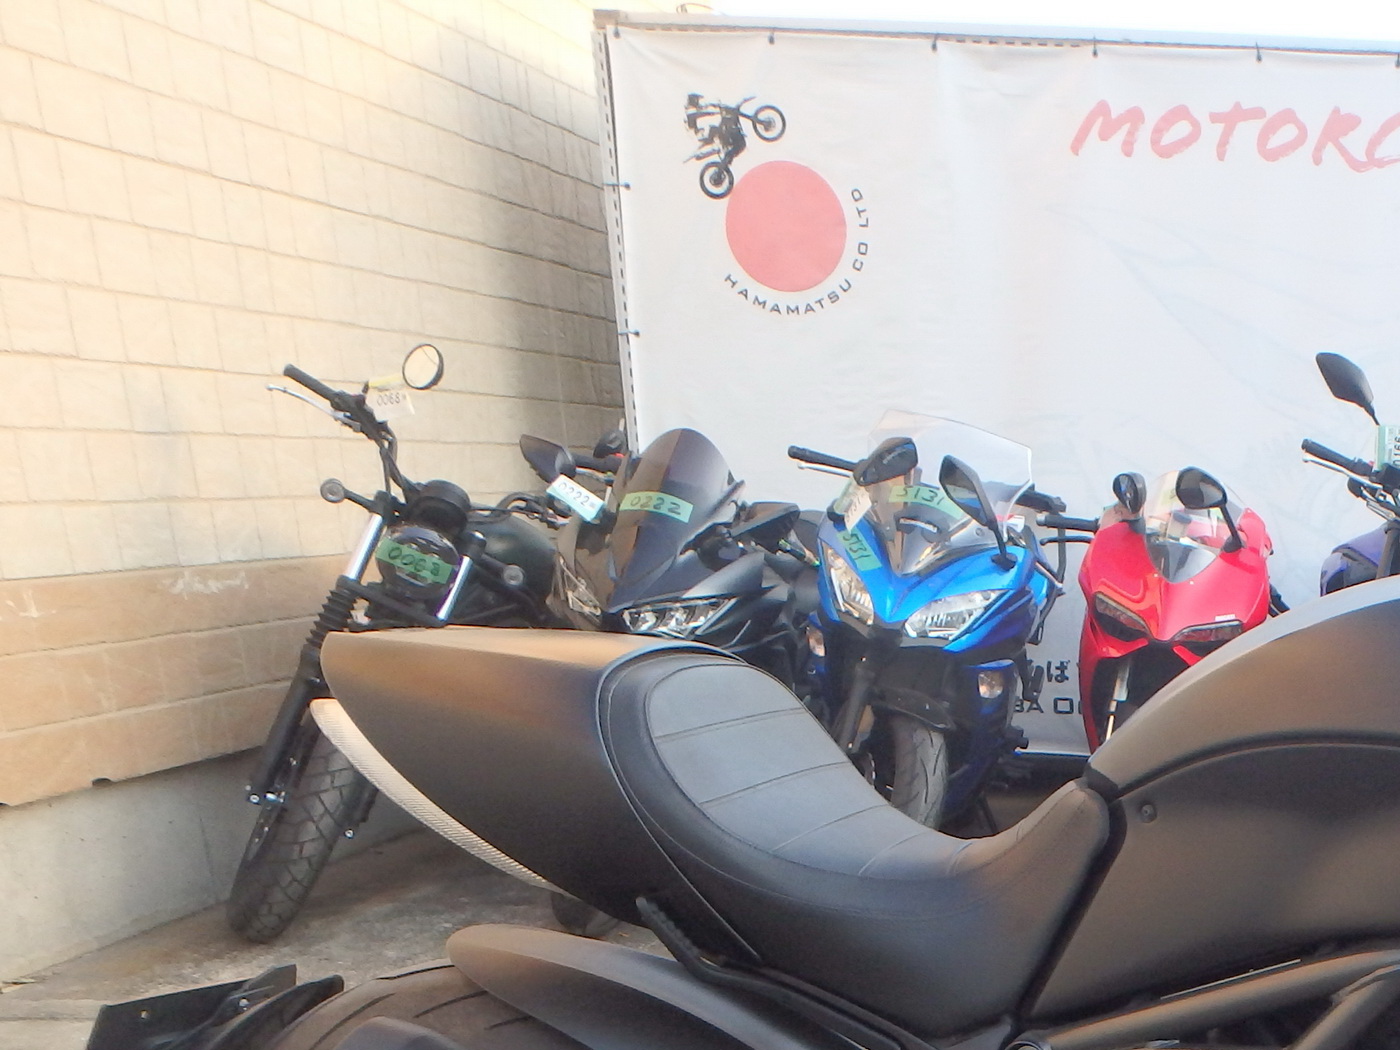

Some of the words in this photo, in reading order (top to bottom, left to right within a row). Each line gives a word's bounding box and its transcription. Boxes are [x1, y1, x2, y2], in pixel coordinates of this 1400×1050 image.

[851, 188, 869, 228] LTD
[852, 242, 869, 272] CO
[724, 274, 852, 316] HAMAMATSU
